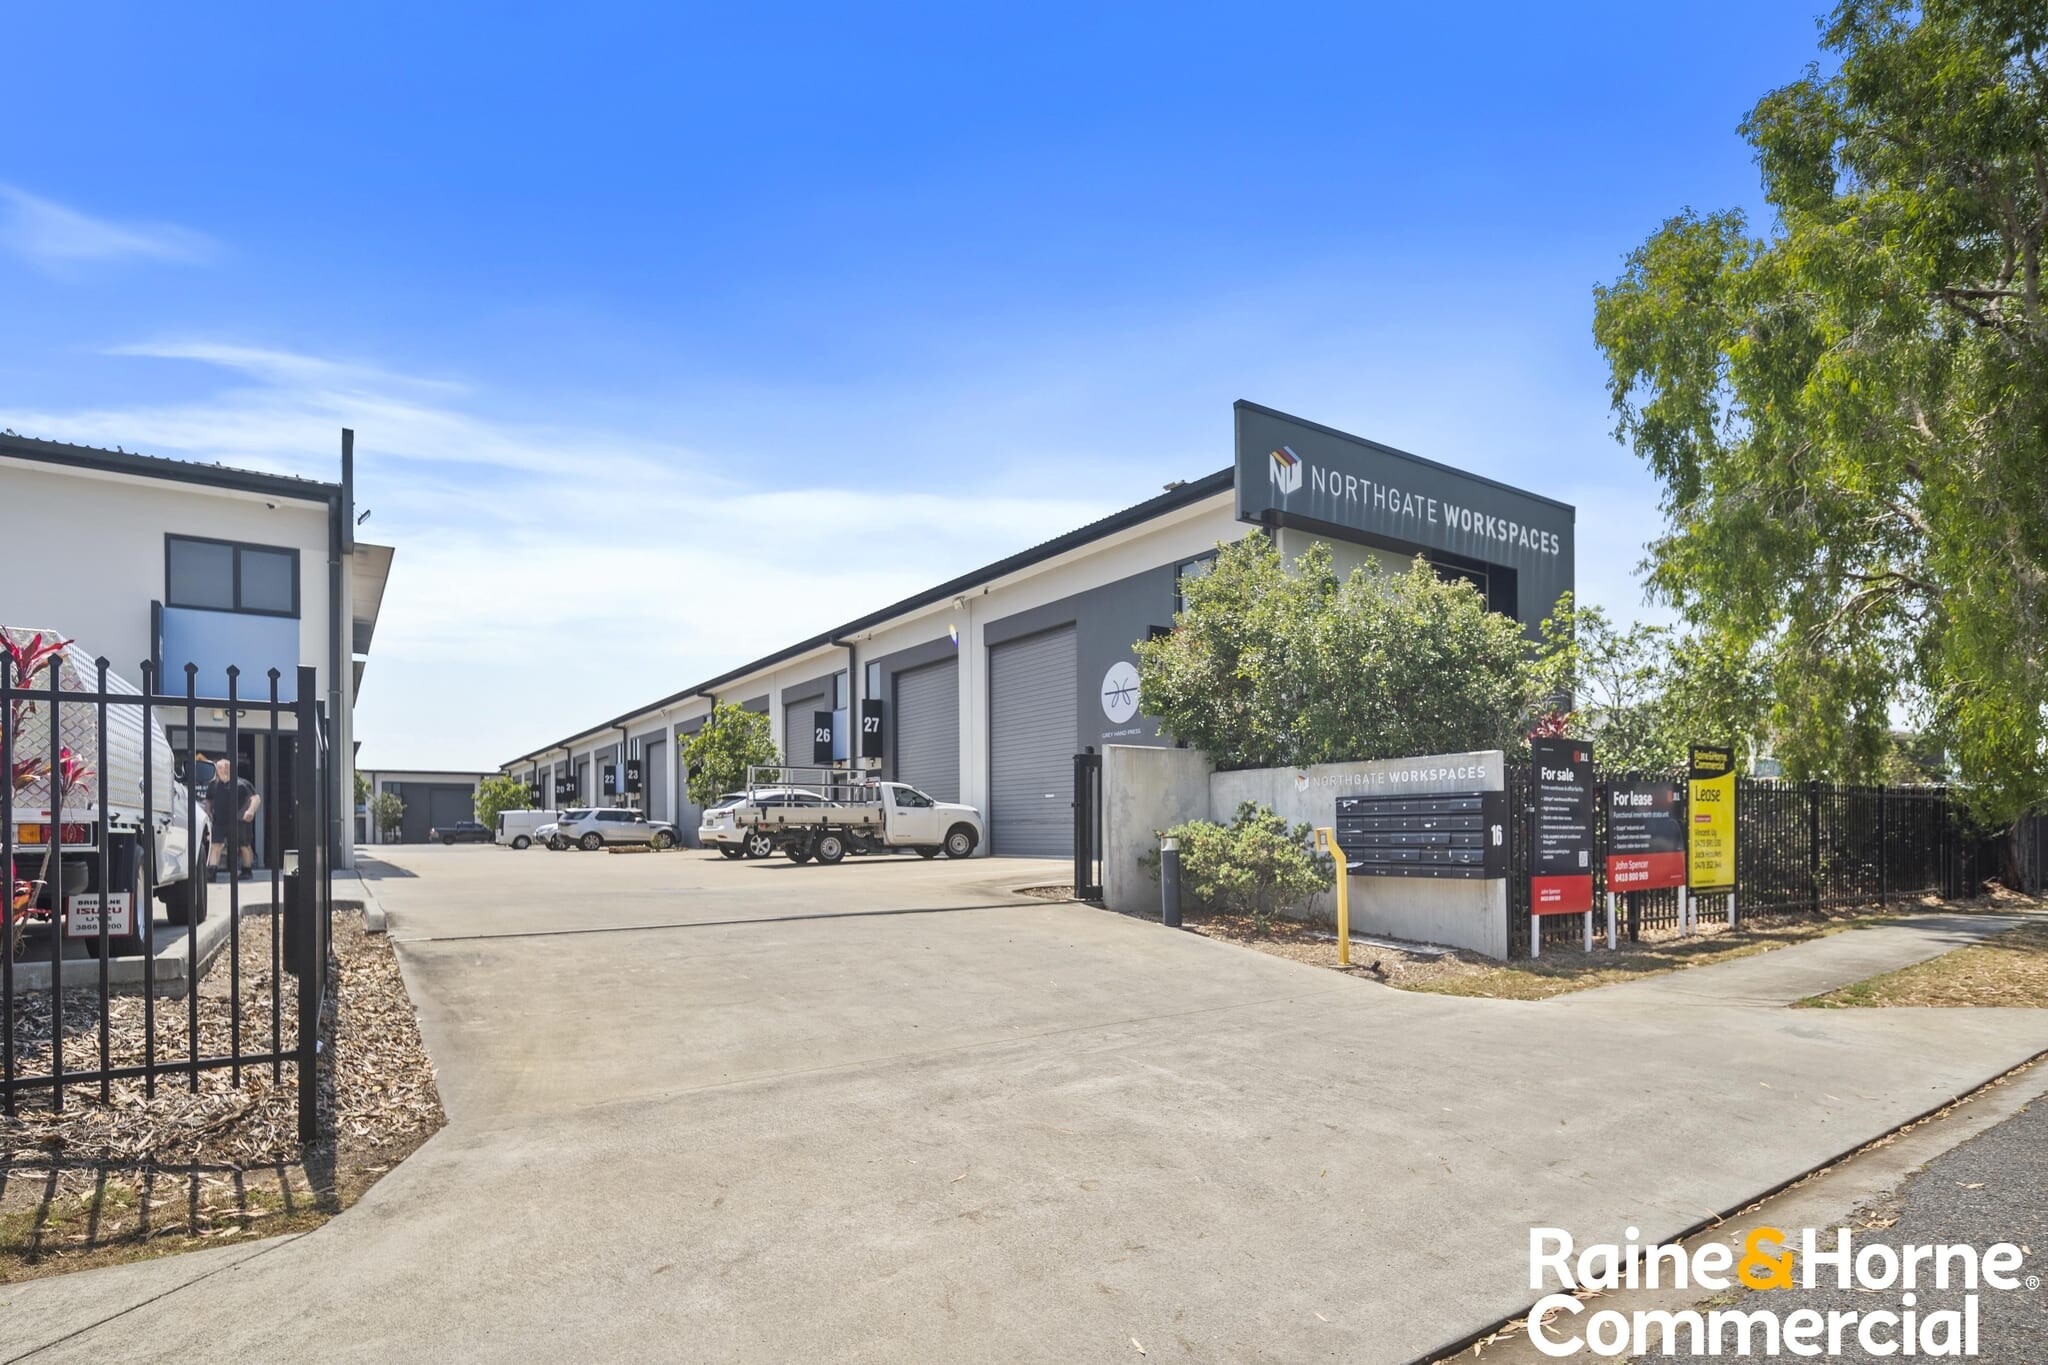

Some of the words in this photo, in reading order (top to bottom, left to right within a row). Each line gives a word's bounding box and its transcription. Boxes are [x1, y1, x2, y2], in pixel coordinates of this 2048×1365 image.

[1312, 465, 1438, 523] NORTHGATE
[1444, 503, 1560, 555] WORKSPACES
[864, 716, 880, 733] 27
[815, 728, 831, 742] 26
[604, 775, 614, 783] 22
[628, 770, 638, 779] 23
[1313, 772, 1385, 788] NORTHGATE
[1389, 766, 1486, 783] WORKSPACES
[1541, 767, 1556, 780] For
[1557, 768, 1574, 781] sale
[566, 783, 575, 791] 21
[1696, 785, 1720, 802] Lease
[1613, 791, 1629, 806] For
[1630, 790, 1653, 806] lease
[1491, 825, 1503, 846] 16
[1615, 861, 1628, 870] John
[1628, 860, 1649, 871] Spencer
